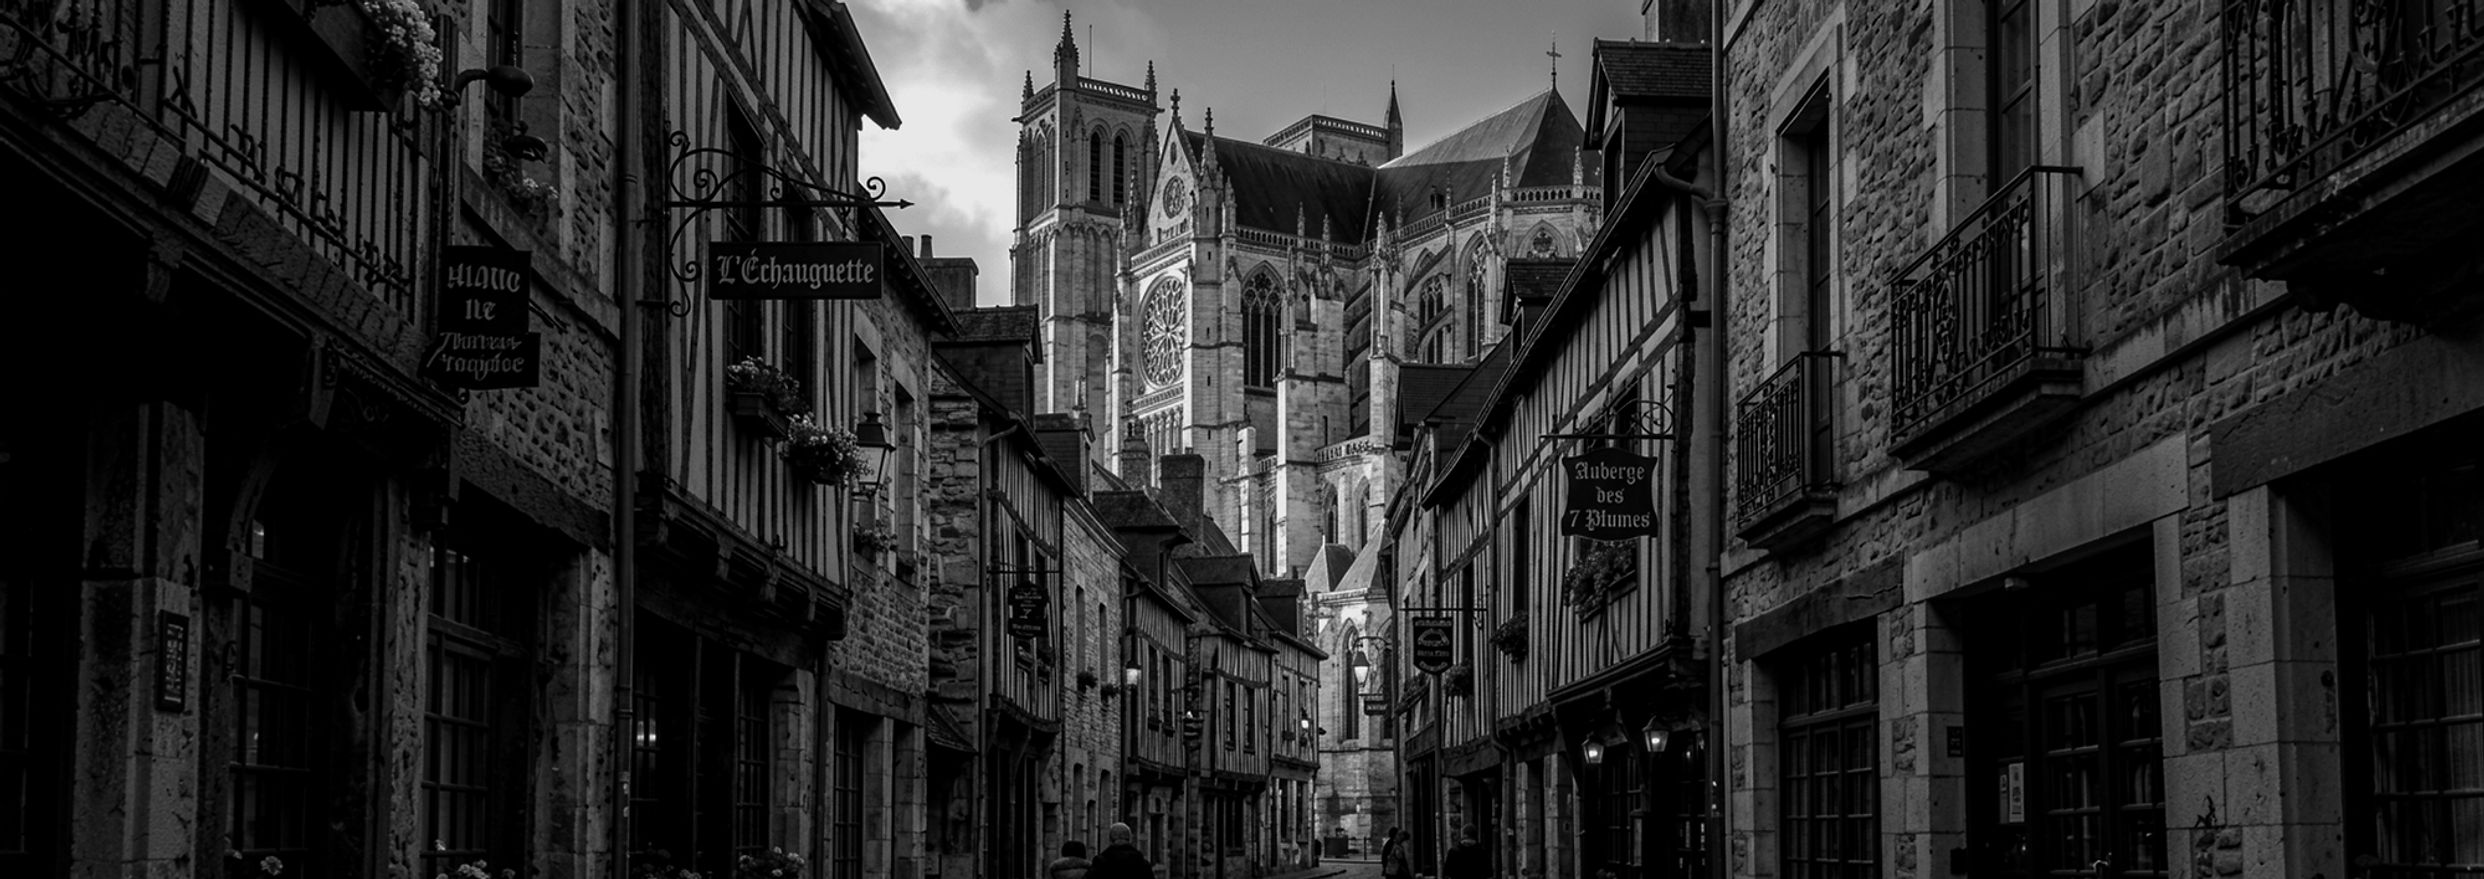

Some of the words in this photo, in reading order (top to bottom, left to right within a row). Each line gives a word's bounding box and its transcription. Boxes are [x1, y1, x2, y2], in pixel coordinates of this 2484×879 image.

[716, 248, 875, 290] L'Échauguette
[1574, 460, 1646, 485] Auberge
[1595, 485, 1625, 504] des
[1569, 508, 1581, 528] 7
[1585, 508, 1650, 531] Plumes
